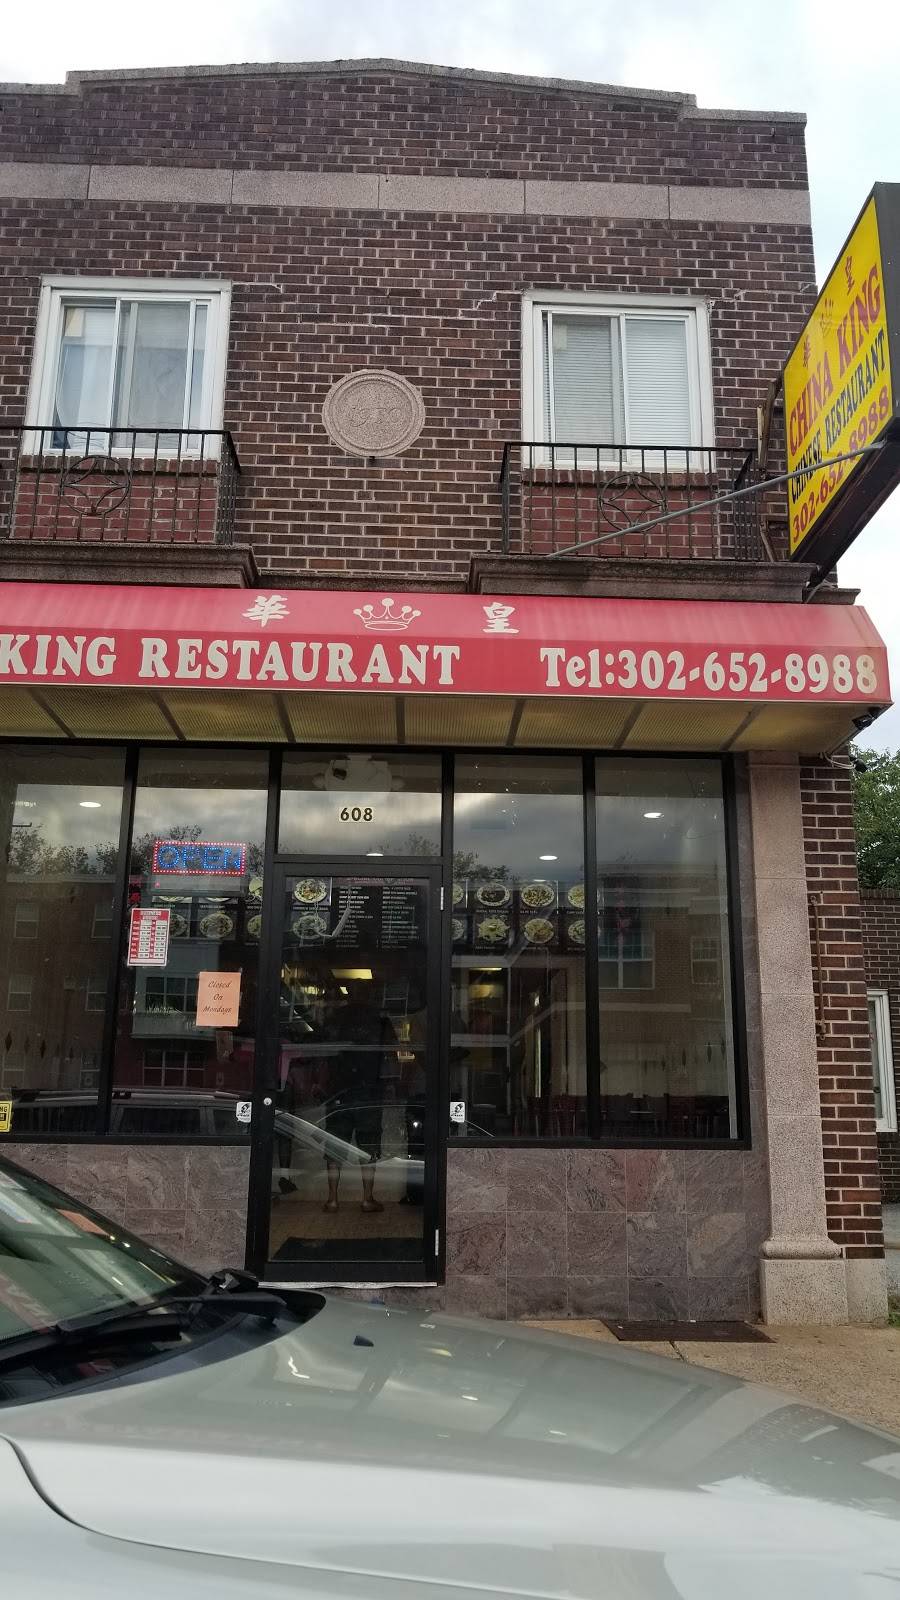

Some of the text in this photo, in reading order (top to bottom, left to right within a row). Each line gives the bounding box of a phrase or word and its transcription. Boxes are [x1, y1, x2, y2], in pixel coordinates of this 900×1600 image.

[790, 263, 881, 457] CHINA KING
[791, 328, 885, 504] CHINESE RESTAURANT
[482, 602, 519, 633] 皇
[0, 634, 878, 694] KING RESTAURANT Tel:302-652-8988
[340, 807, 373, 821] 608
[158, 845, 242, 870] OPEN
[208, 980, 232, 988] Closed
[213, 993, 224, 1001] On
